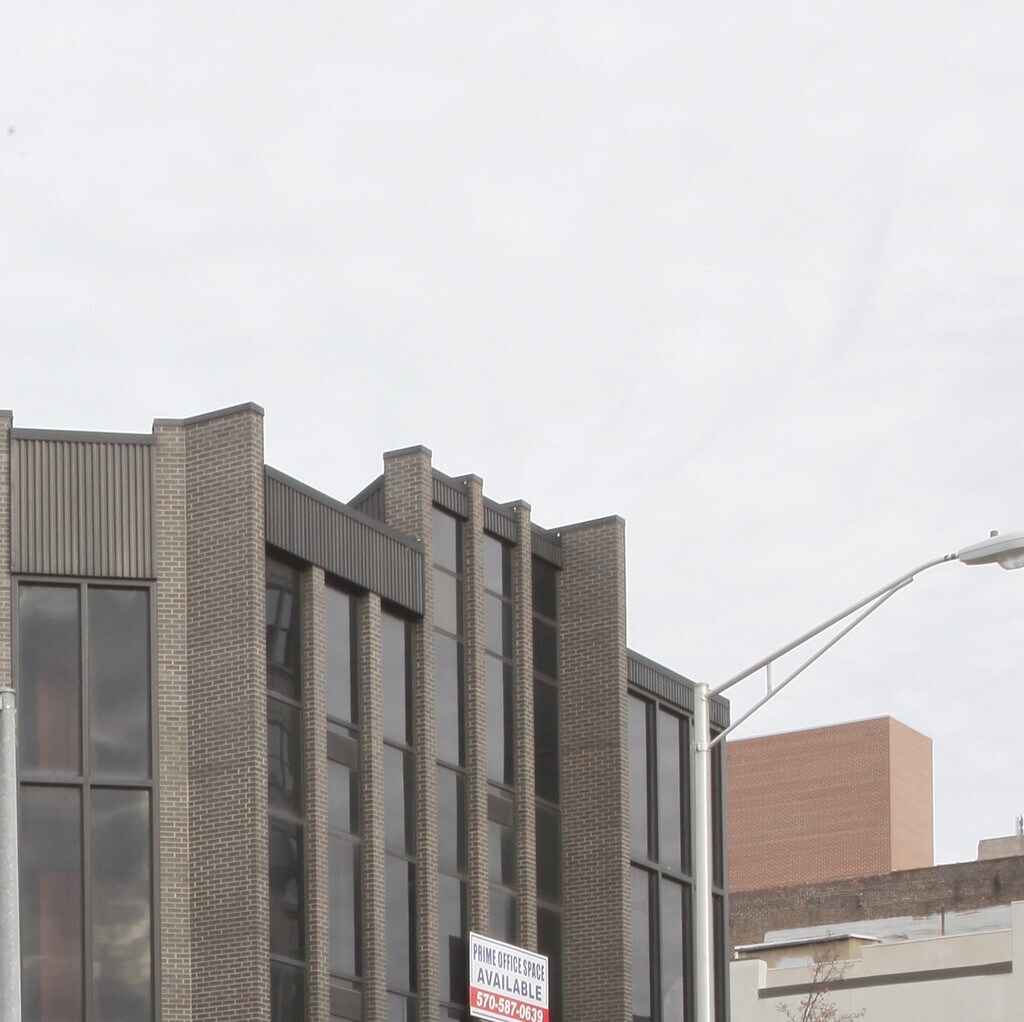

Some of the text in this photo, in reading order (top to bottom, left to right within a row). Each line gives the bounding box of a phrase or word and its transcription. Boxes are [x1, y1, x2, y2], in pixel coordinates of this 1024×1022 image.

[473, 942, 545, 982] PRIME OFFICE SPACE
[477, 967, 542, 1002] AVAILABLE
